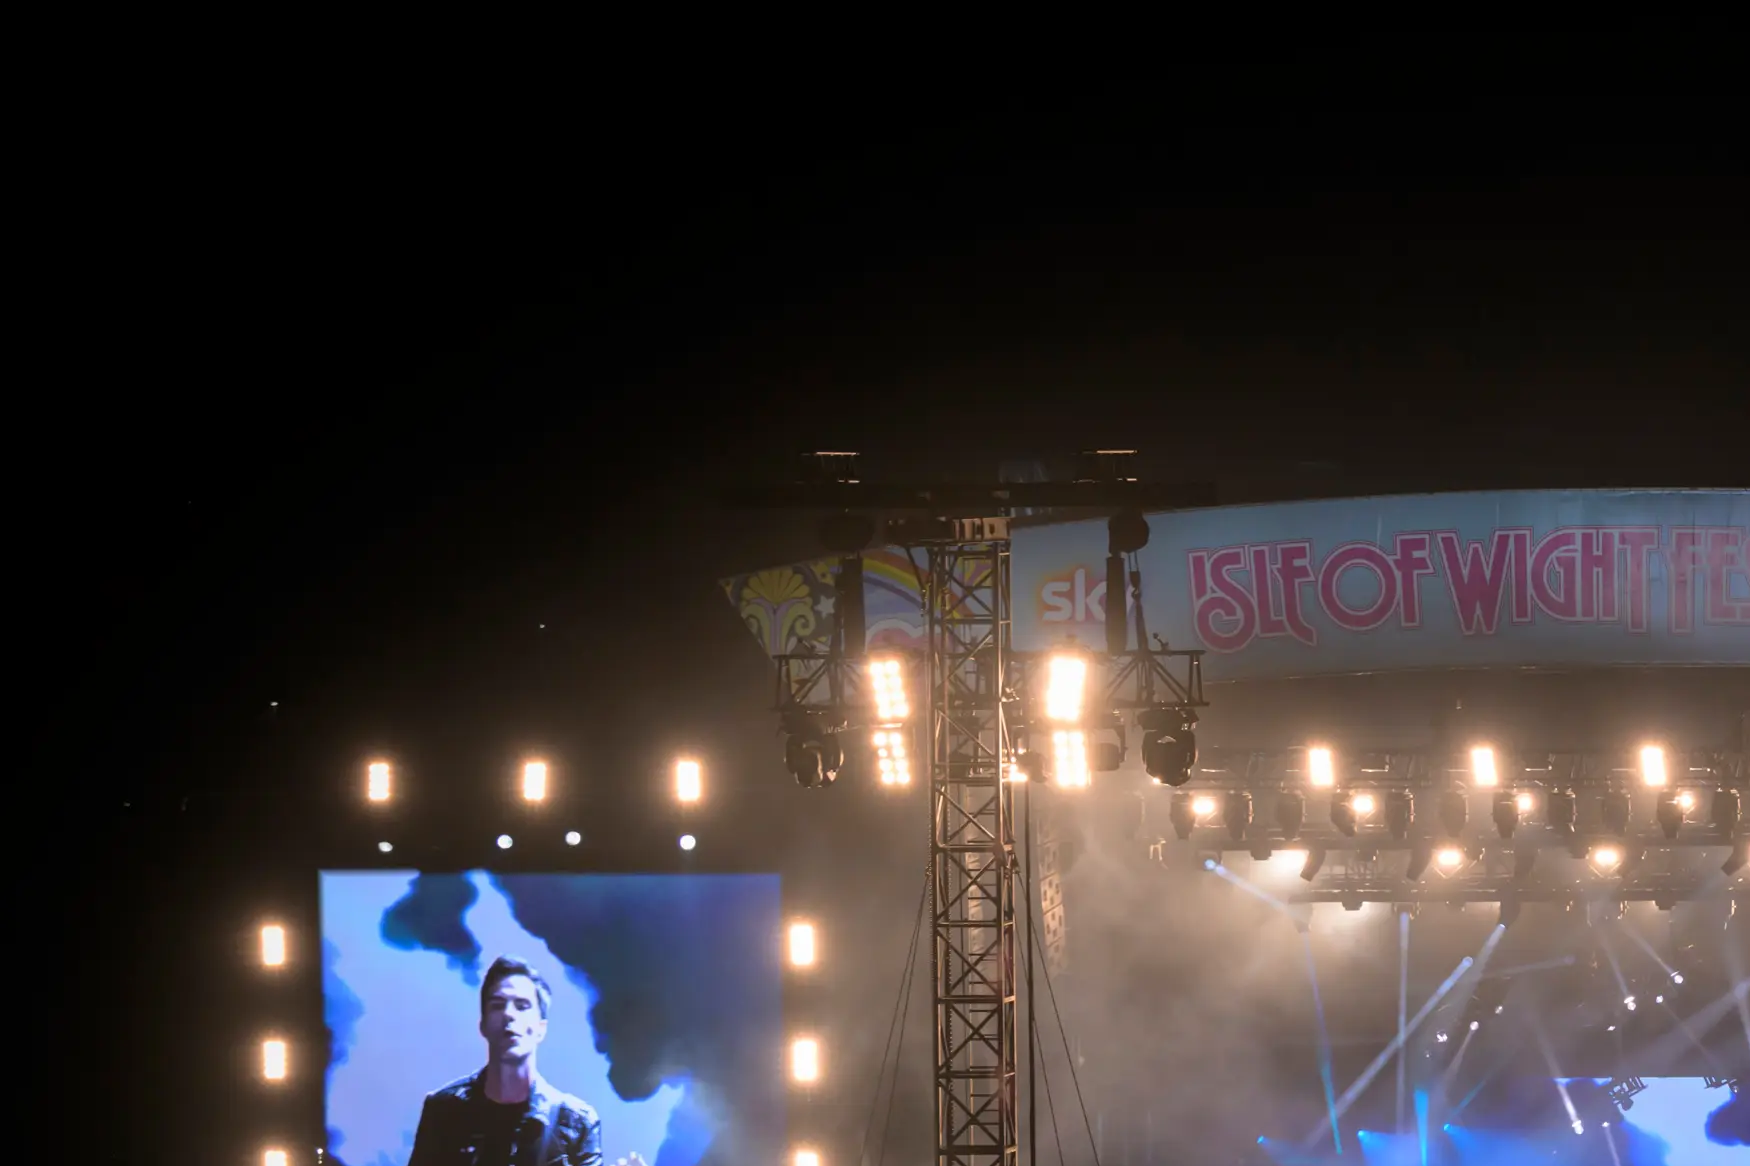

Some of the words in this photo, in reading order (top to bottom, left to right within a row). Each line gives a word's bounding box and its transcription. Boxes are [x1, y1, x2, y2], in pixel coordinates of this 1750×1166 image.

[1041, 568, 1136, 623] sk
[1186, 539, 1319, 653] ISLE
[1317, 530, 1437, 632] OF
[1431, 525, 1661, 636] WIGHT
